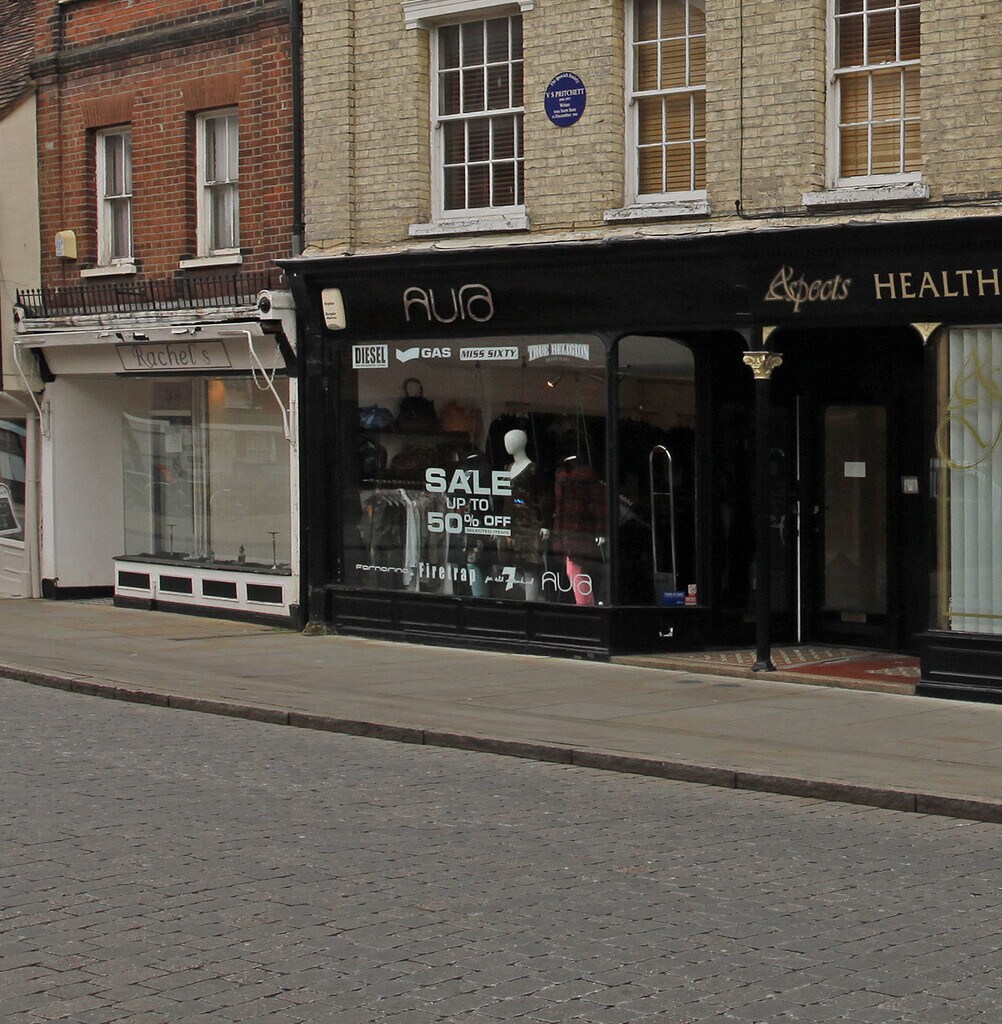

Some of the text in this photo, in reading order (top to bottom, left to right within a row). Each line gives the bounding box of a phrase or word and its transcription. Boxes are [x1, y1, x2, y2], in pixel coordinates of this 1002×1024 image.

[556, 88, 584, 98] PRITCHETT
[763, 264, 852, 313] Aspects
[873, 268, 1001, 300] HEALTH
[133, 344, 212, 368] Rachel's
[355, 346, 386, 364] DIESEL
[421, 347, 452, 358] GAS
[460, 347, 518, 359] MISS SIXTY
[527, 342, 590, 362] TRUE RELIGION
[425, 467, 512, 496] SALE
[446, 496, 489, 512] UP TO
[427, 511, 511, 534] 50% OFF
[419, 562, 476, 587] Firetrap
[501, 566, 517, 592] 7
